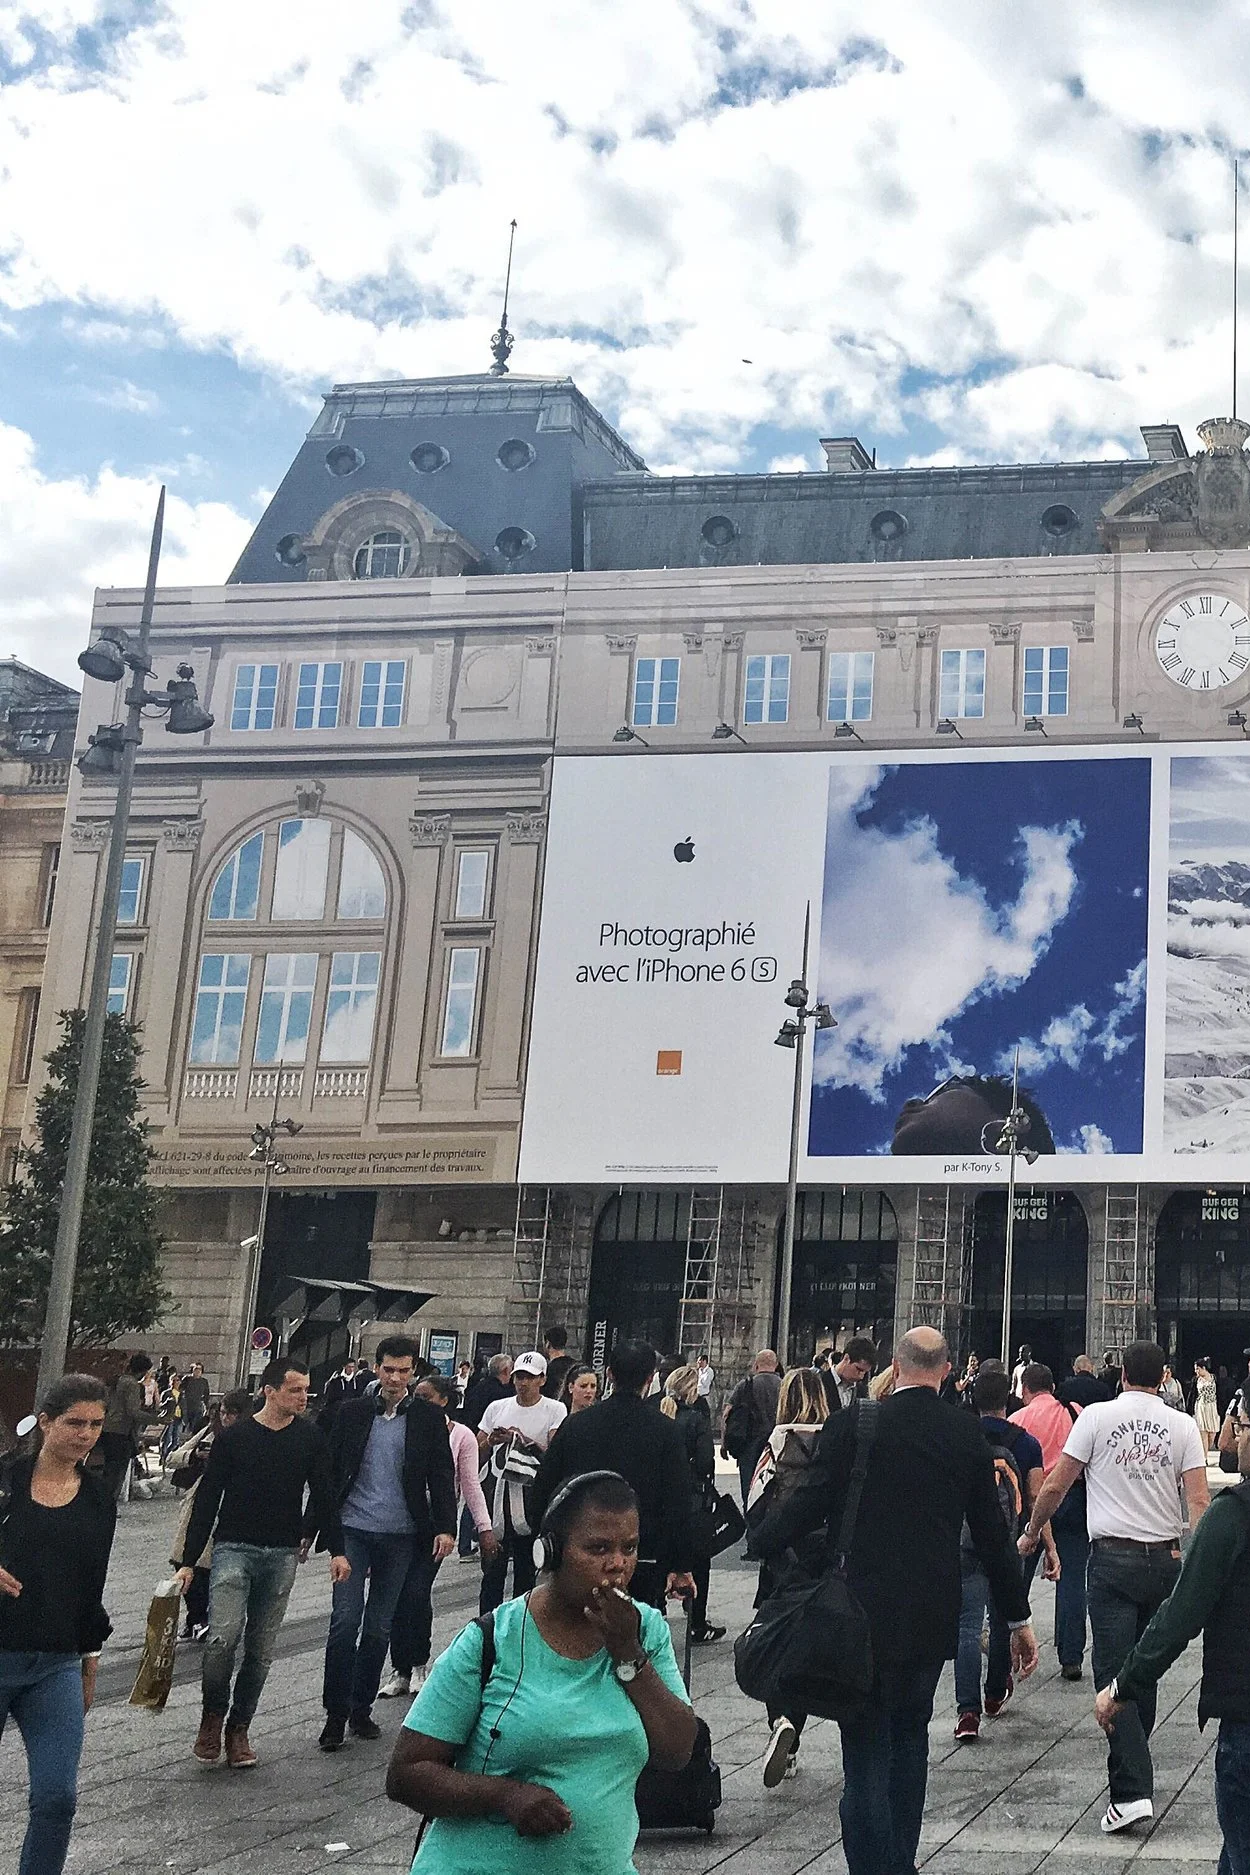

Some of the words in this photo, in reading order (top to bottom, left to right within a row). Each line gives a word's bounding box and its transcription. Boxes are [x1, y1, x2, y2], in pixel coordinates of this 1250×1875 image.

[600, 921, 756, 952] Photographié
[576, 964, 630, 982] avec
[636, 957, 725, 982] l'iPhone
[731, 957, 746, 981] 6
[317, 1151, 330, 1160] les
[332, 1151, 366, 1160] recettes
[368, 1152, 406, 1162] perçues
[405, 1150, 421, 1161] par
[422, 1149, 431, 1159] le
[433, 1149, 487, 1160] propriétaire
[358, 1166, 370, 1174] au
[372, 1163, 428, 1173] financement
[429, 1163, 446, 1173] des
[944, 1164, 960, 1173] par
[962, 1163, 993, 1173] K-Tony
[995, 1162, 1003, 1171] S.
[1013, 1198, 1048, 1207] BURGER
[1202, 1198, 1239, 1207] BURGER
[1013, 1207, 1048, 1220] KING
[1201, 1207, 1239, 1220] KING
[1106, 1419, 1169, 1449] CONVERSE
